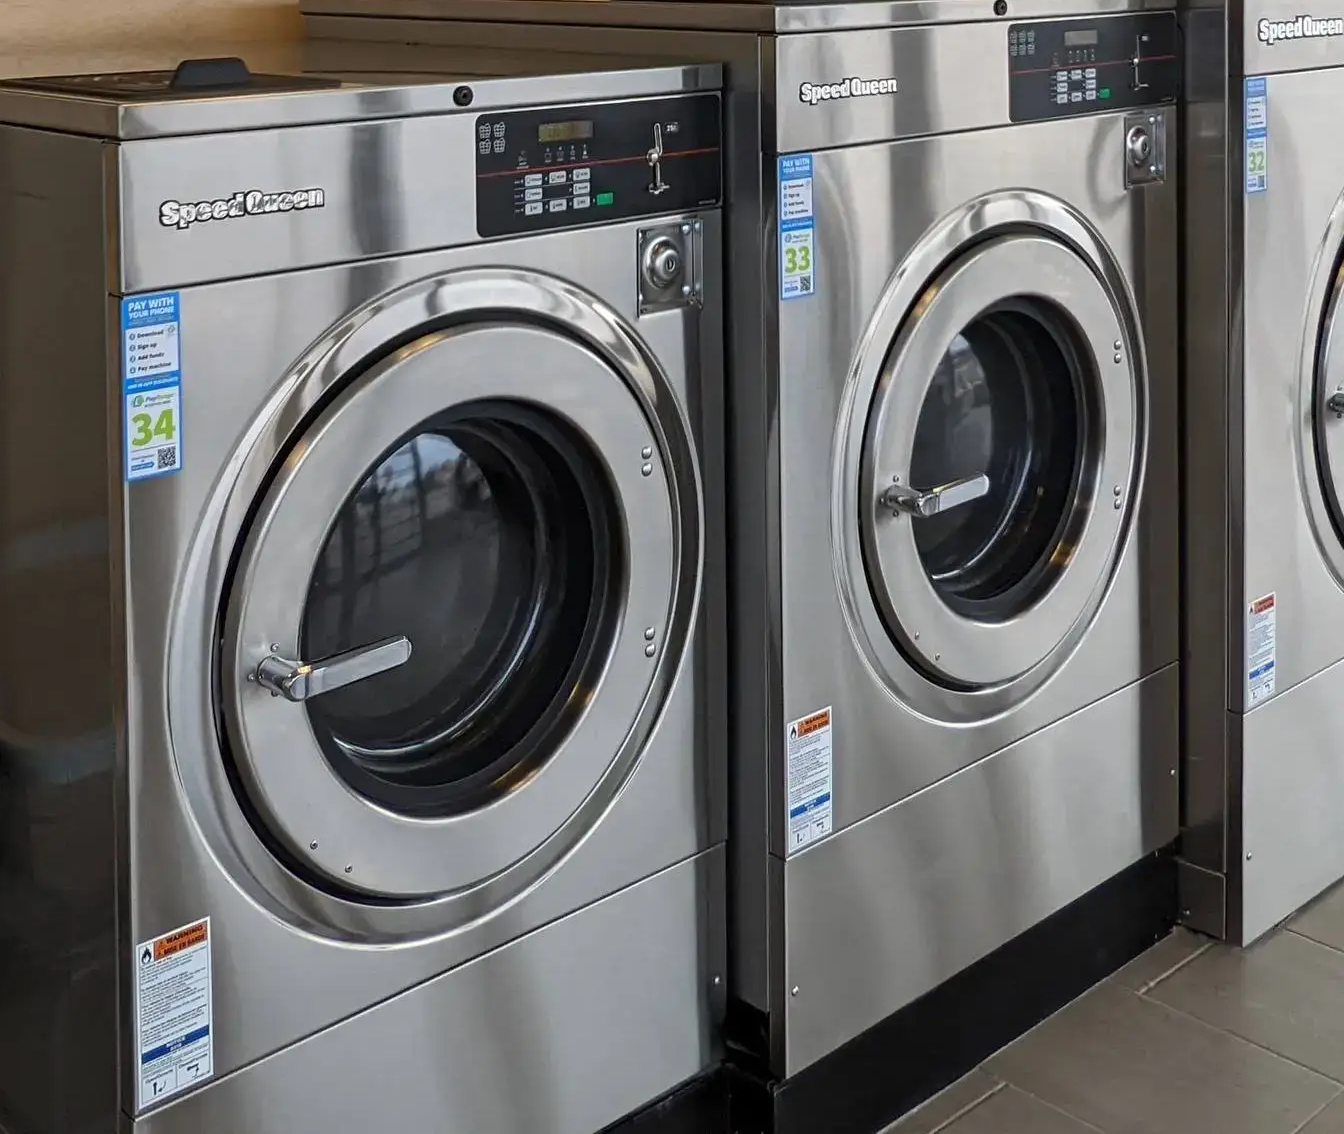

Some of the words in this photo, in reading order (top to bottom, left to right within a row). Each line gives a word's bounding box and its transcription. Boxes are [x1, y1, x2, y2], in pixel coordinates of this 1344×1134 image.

[1258, 15, 1303, 46] Speed
[1303, 15, 1344, 38] Queen
[800, 78, 850, 105] Speed
[850, 77, 898, 97] Queen
[160, 192, 244, 230] Speed
[245, 188, 325, 215] Queen
[784, 245, 811, 275] 33
[128, 300, 147, 312] PAY
[148, 297, 174, 309] WITH
[129, 310, 148, 319] YOUR
[149, 306, 174, 316] PHONE
[138, 365, 148, 373] Pay
[131, 408, 176, 446] 34
[166, 924, 203, 944] WARNING
